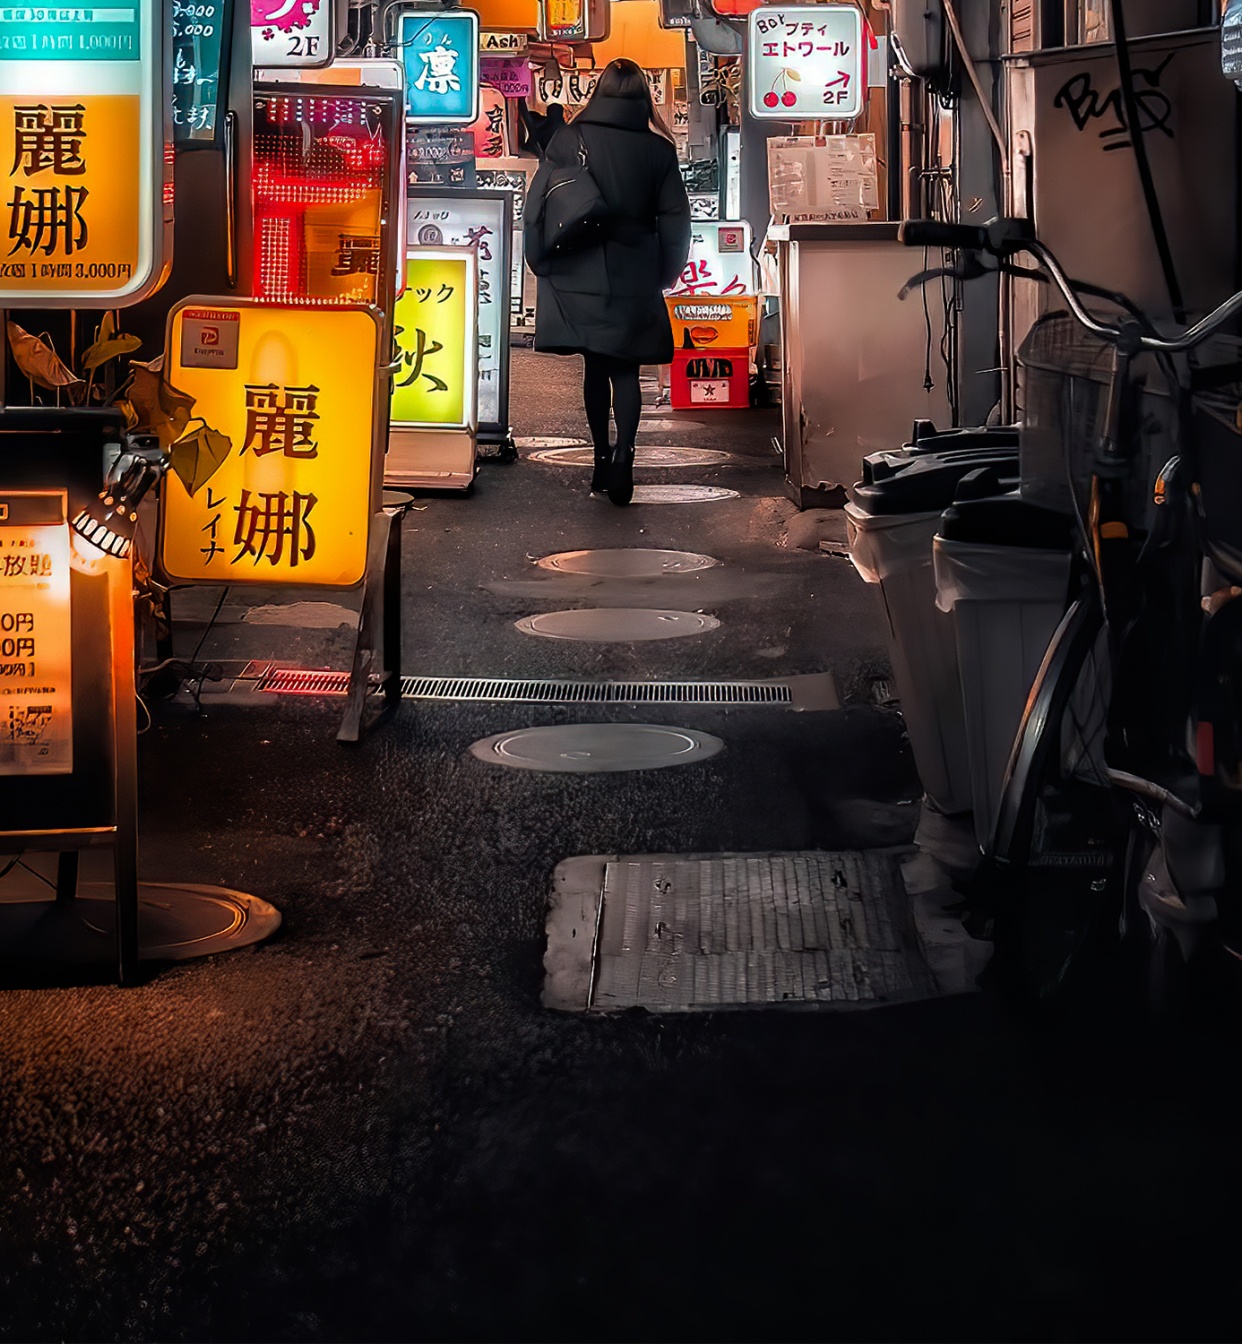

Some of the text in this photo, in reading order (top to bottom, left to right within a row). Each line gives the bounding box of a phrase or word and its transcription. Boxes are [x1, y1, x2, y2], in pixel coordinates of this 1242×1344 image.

[286, 36, 320, 56] 2F
[762, 41, 851, 57] エトワール
[823, 91, 848, 105] 2F
[7, 103, 90, 257] 麗娜
[231, 383, 321, 567] 麗娜
[199, 487, 227, 567] レイナ
